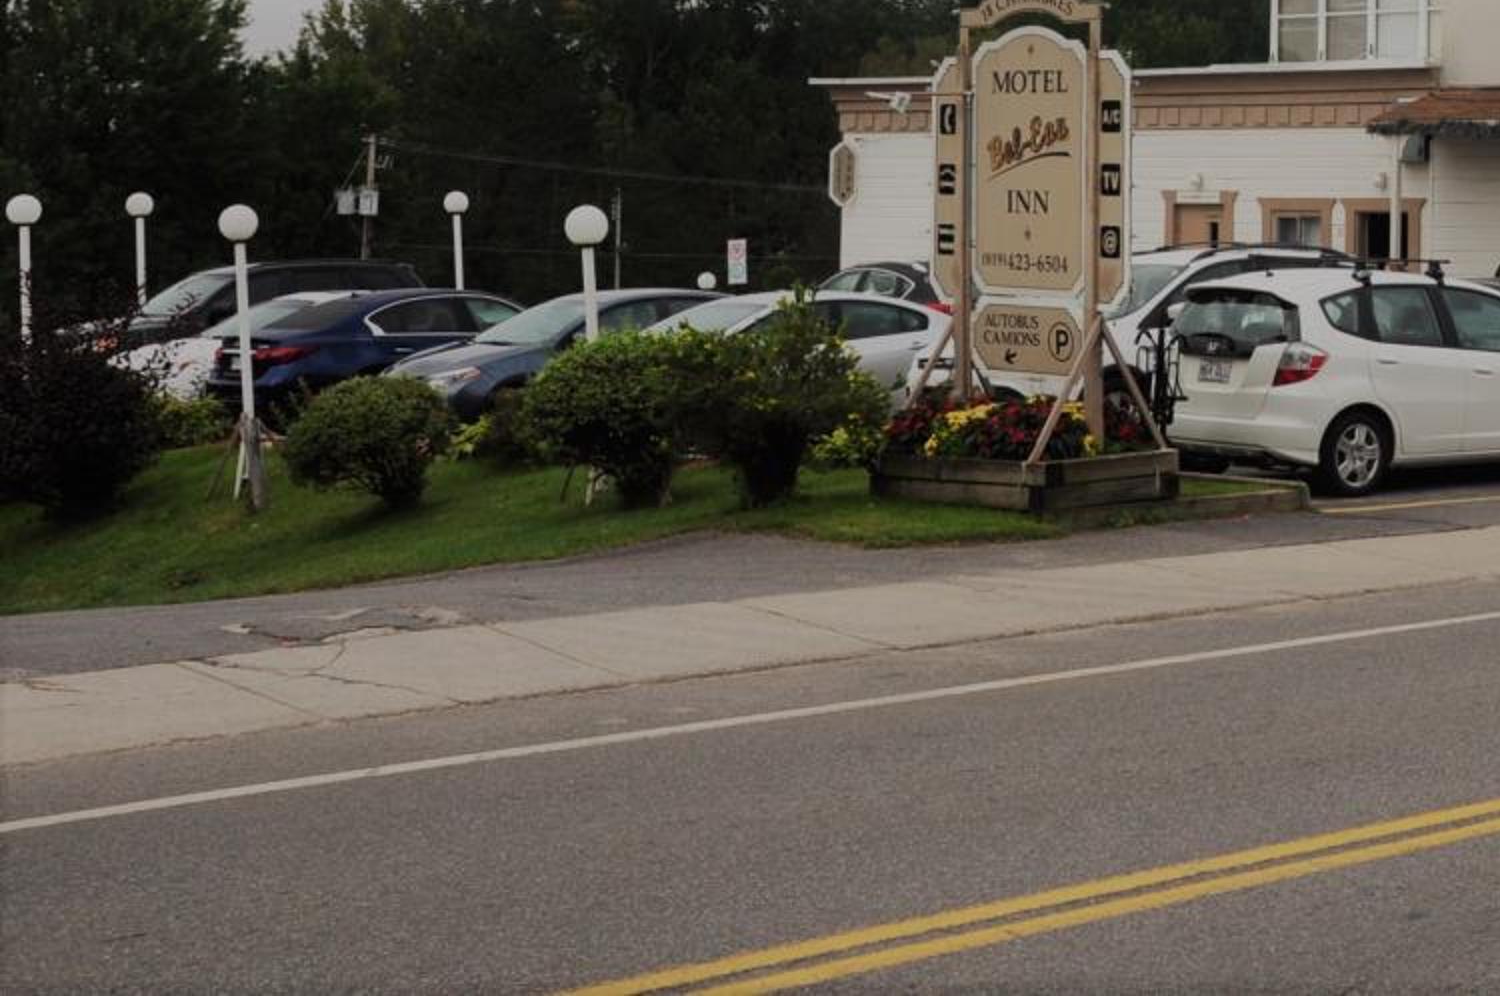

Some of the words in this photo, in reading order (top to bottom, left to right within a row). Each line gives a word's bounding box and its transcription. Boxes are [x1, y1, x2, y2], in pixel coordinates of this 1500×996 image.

[992, 70, 1068, 94] MOTEL
[1103, 172, 1119, 191] TV
[1008, 190, 1049, 215] INN
[984, 314, 1039, 329] AUTOBUS
[983, 330, 1041, 347] CAMIONS
[1056, 329, 1069, 355] P
